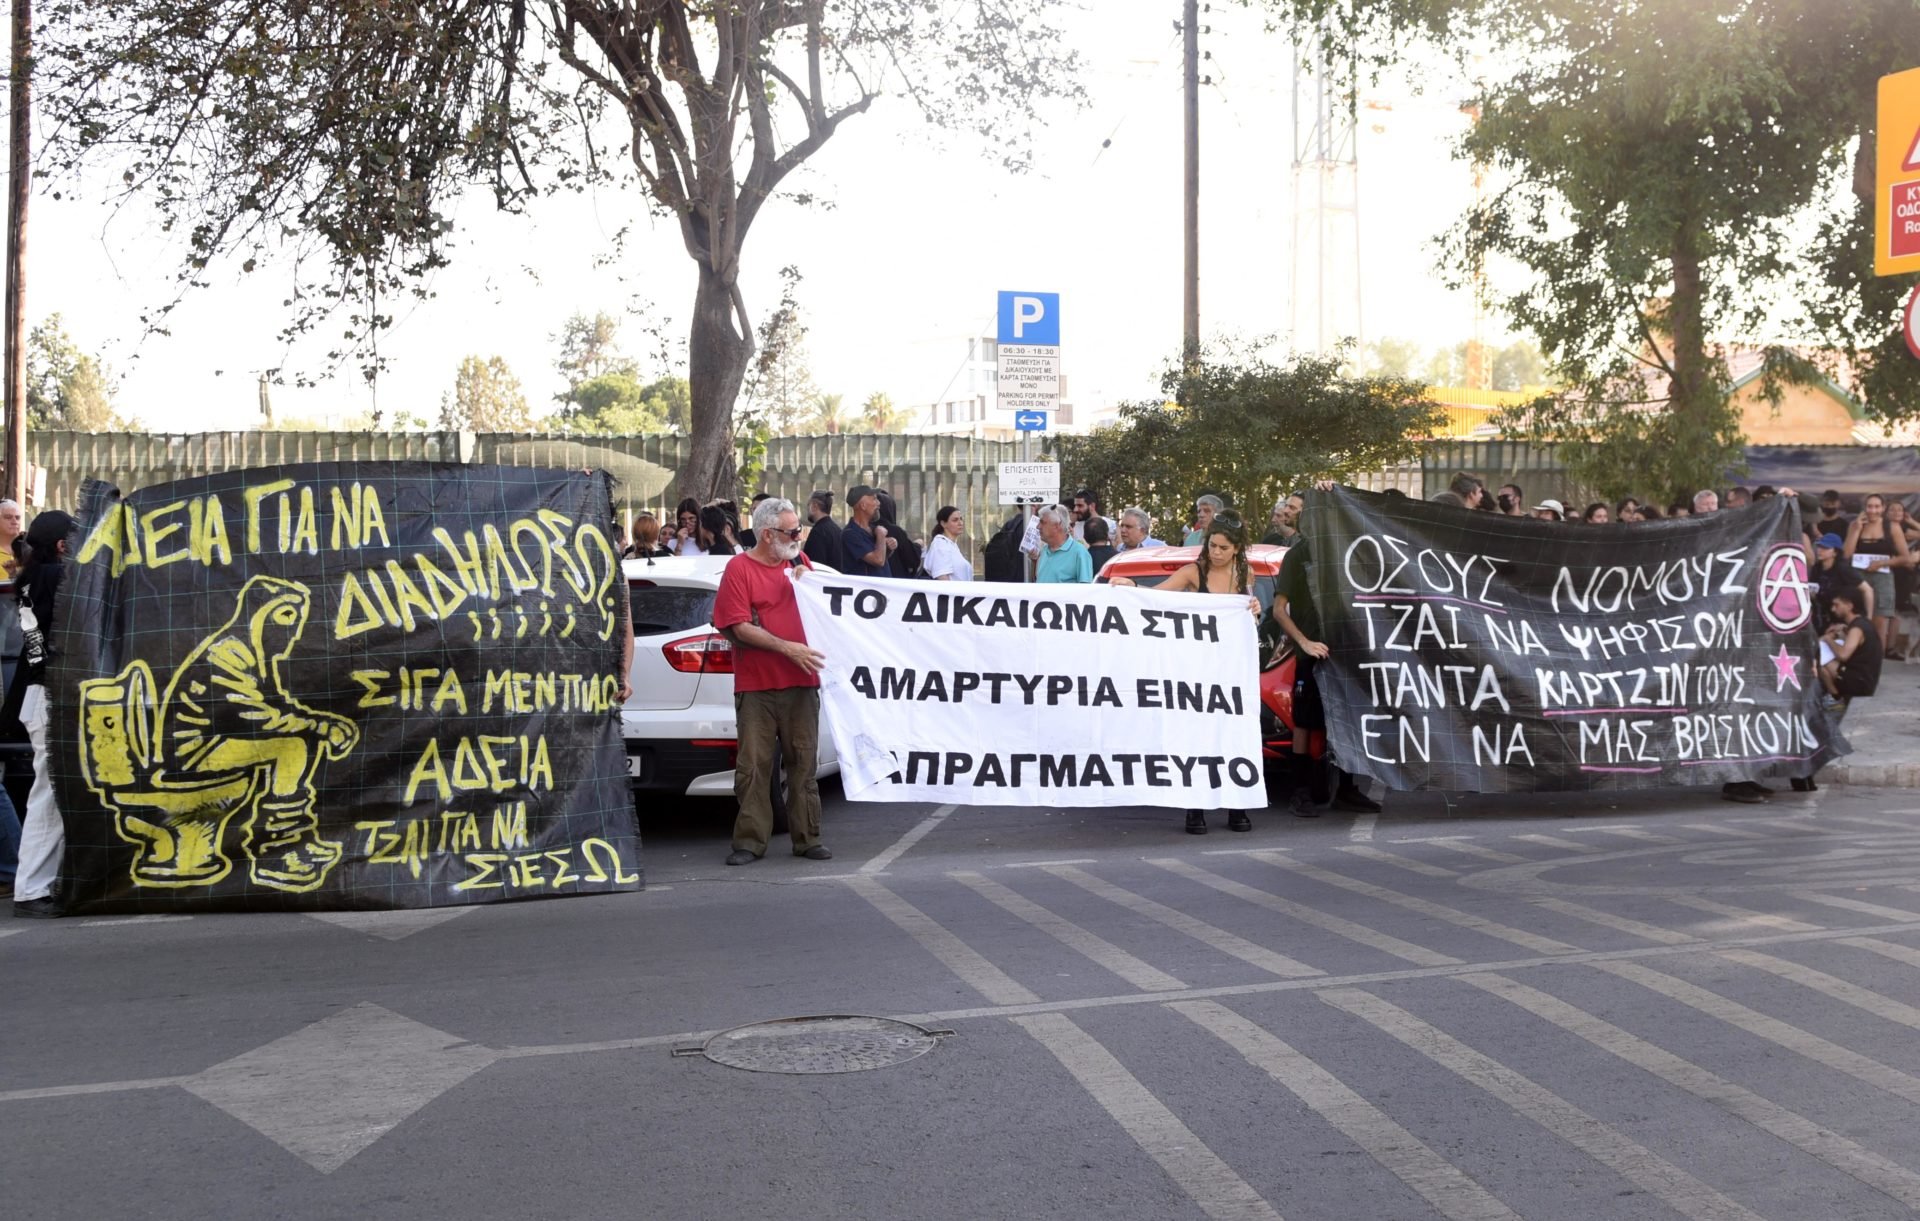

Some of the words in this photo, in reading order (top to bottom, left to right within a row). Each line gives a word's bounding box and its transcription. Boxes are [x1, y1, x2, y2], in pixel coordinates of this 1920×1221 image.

[1013, 296, 1044, 338] P
[1038, 392, 1059, 400] PERMIT
[1004, 466, 1053, 474] ΕΠΙΣΚΕΠΤΕΣ
[244, 478, 318, 555] ΓΙΑ
[331, 481, 391, 551] ΝΑ
[1344, 534, 1511, 607] ΟΣΟΥΣ
[1551, 546, 1748, 614] ΝΟΜΟΥΣ
[823, 586, 888, 620] ΤΟ
[901, 592, 1129, 636] ΔΙΚΑΙΩΜΑ
[1140, 608, 1220, 643] ΣΤΗ
[1352, 602, 1467, 651] ΤΖΑΙ
[1484, 613, 1550, 656] ΝΑ
[350, 666, 468, 715] ΣΙΓΑ
[1136, 678, 1244, 716] ΕΙΝΑΙ
[1358, 661, 1511, 713] ΠΑΝΤΑ
[1695, 663, 1755, 705] ΤΟΥΣ
[1361, 713, 1430, 765] ΕΝ
[1472, 722, 1535, 767] ΝΑ
[1579, 718, 1660, 764] ΜΑΣ
[1672, 711, 1819, 760] ΒΡΙΣΚΟΥΝ
[403, 734, 554, 807] ΑΔΕΙΑ
[491, 800, 529, 850] ΝΑ
[452, 837, 640, 892] ΣΙΕΣΩ
